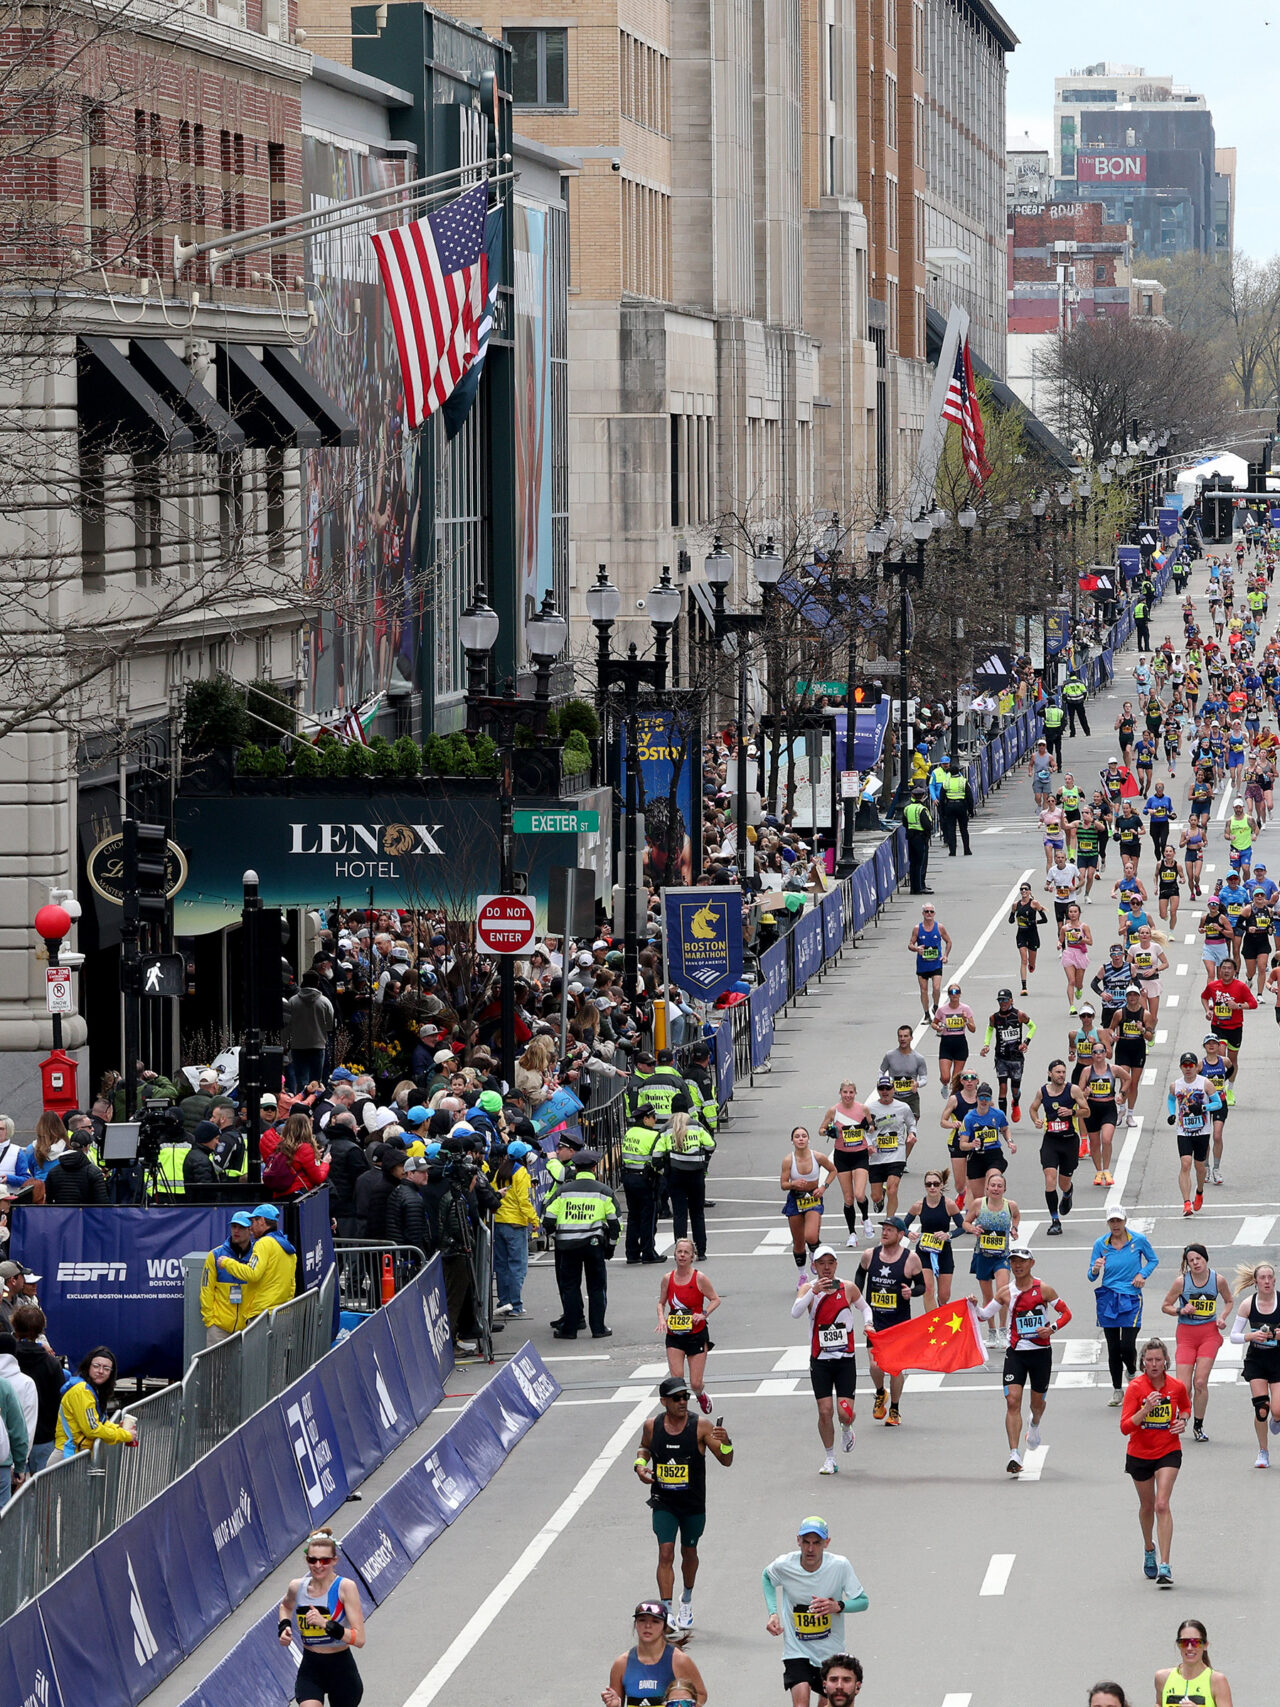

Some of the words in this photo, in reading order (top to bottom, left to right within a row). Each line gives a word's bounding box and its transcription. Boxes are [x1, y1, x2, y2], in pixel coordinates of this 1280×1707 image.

[1095, 157, 1141, 175] BON
[531, 815, 578, 832] EXETER
[580, 822, 589, 832] ST
[335, 861, 400, 878] HOTEL
[486, 907, 500, 918] DO
[506, 907, 527, 918] NOT
[489, 932, 523, 943] ENTER
[684, 941, 727, 952] BOSTON
[684, 950, 727, 959] MARATHON
[650, 1102, 669, 1110] olice
[565, 1201, 596, 1212] Boston
[564, 1211, 595, 1221] Police
[56, 1262, 127, 1282] ESPN
[871, 1276, 897, 1285] SAYSKY
[872, 1292, 895, 1303] 17491
[1018, 1315, 1043, 1329] 14074
[823, 1329, 843, 1343] 8394
[659, 1465, 687, 1479] 19522
[796, 1614, 829, 1628] 18415
[638, 1679, 658, 1690] BANDIT
